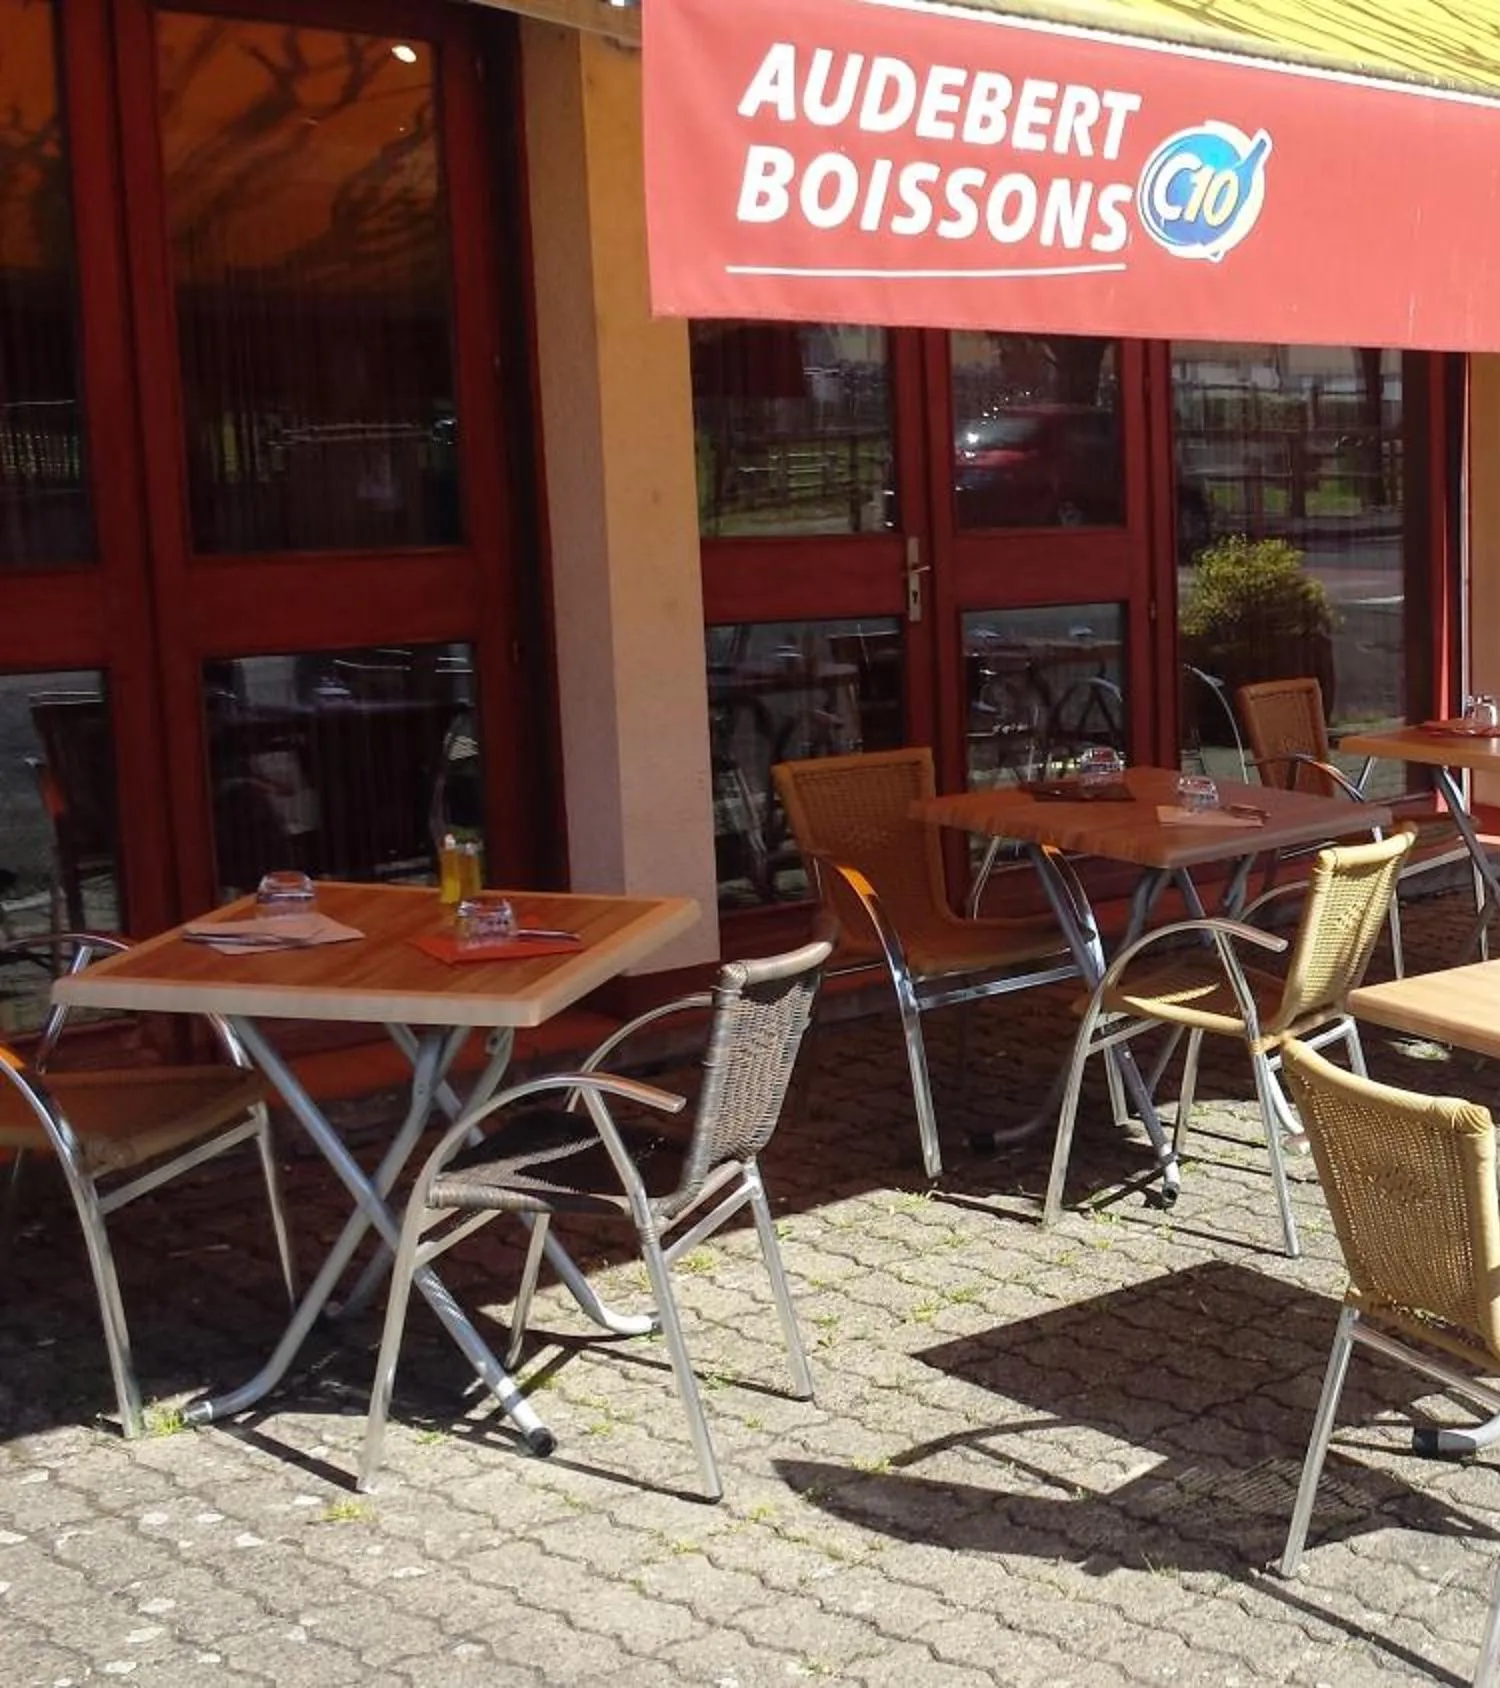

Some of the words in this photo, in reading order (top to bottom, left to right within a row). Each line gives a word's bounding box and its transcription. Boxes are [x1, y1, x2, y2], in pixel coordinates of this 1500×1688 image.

[737, 42, 1142, 160] AUDEBERT
[736, 144, 1133, 253] BOISSONS
[1153, 152, 1240, 228] C10
